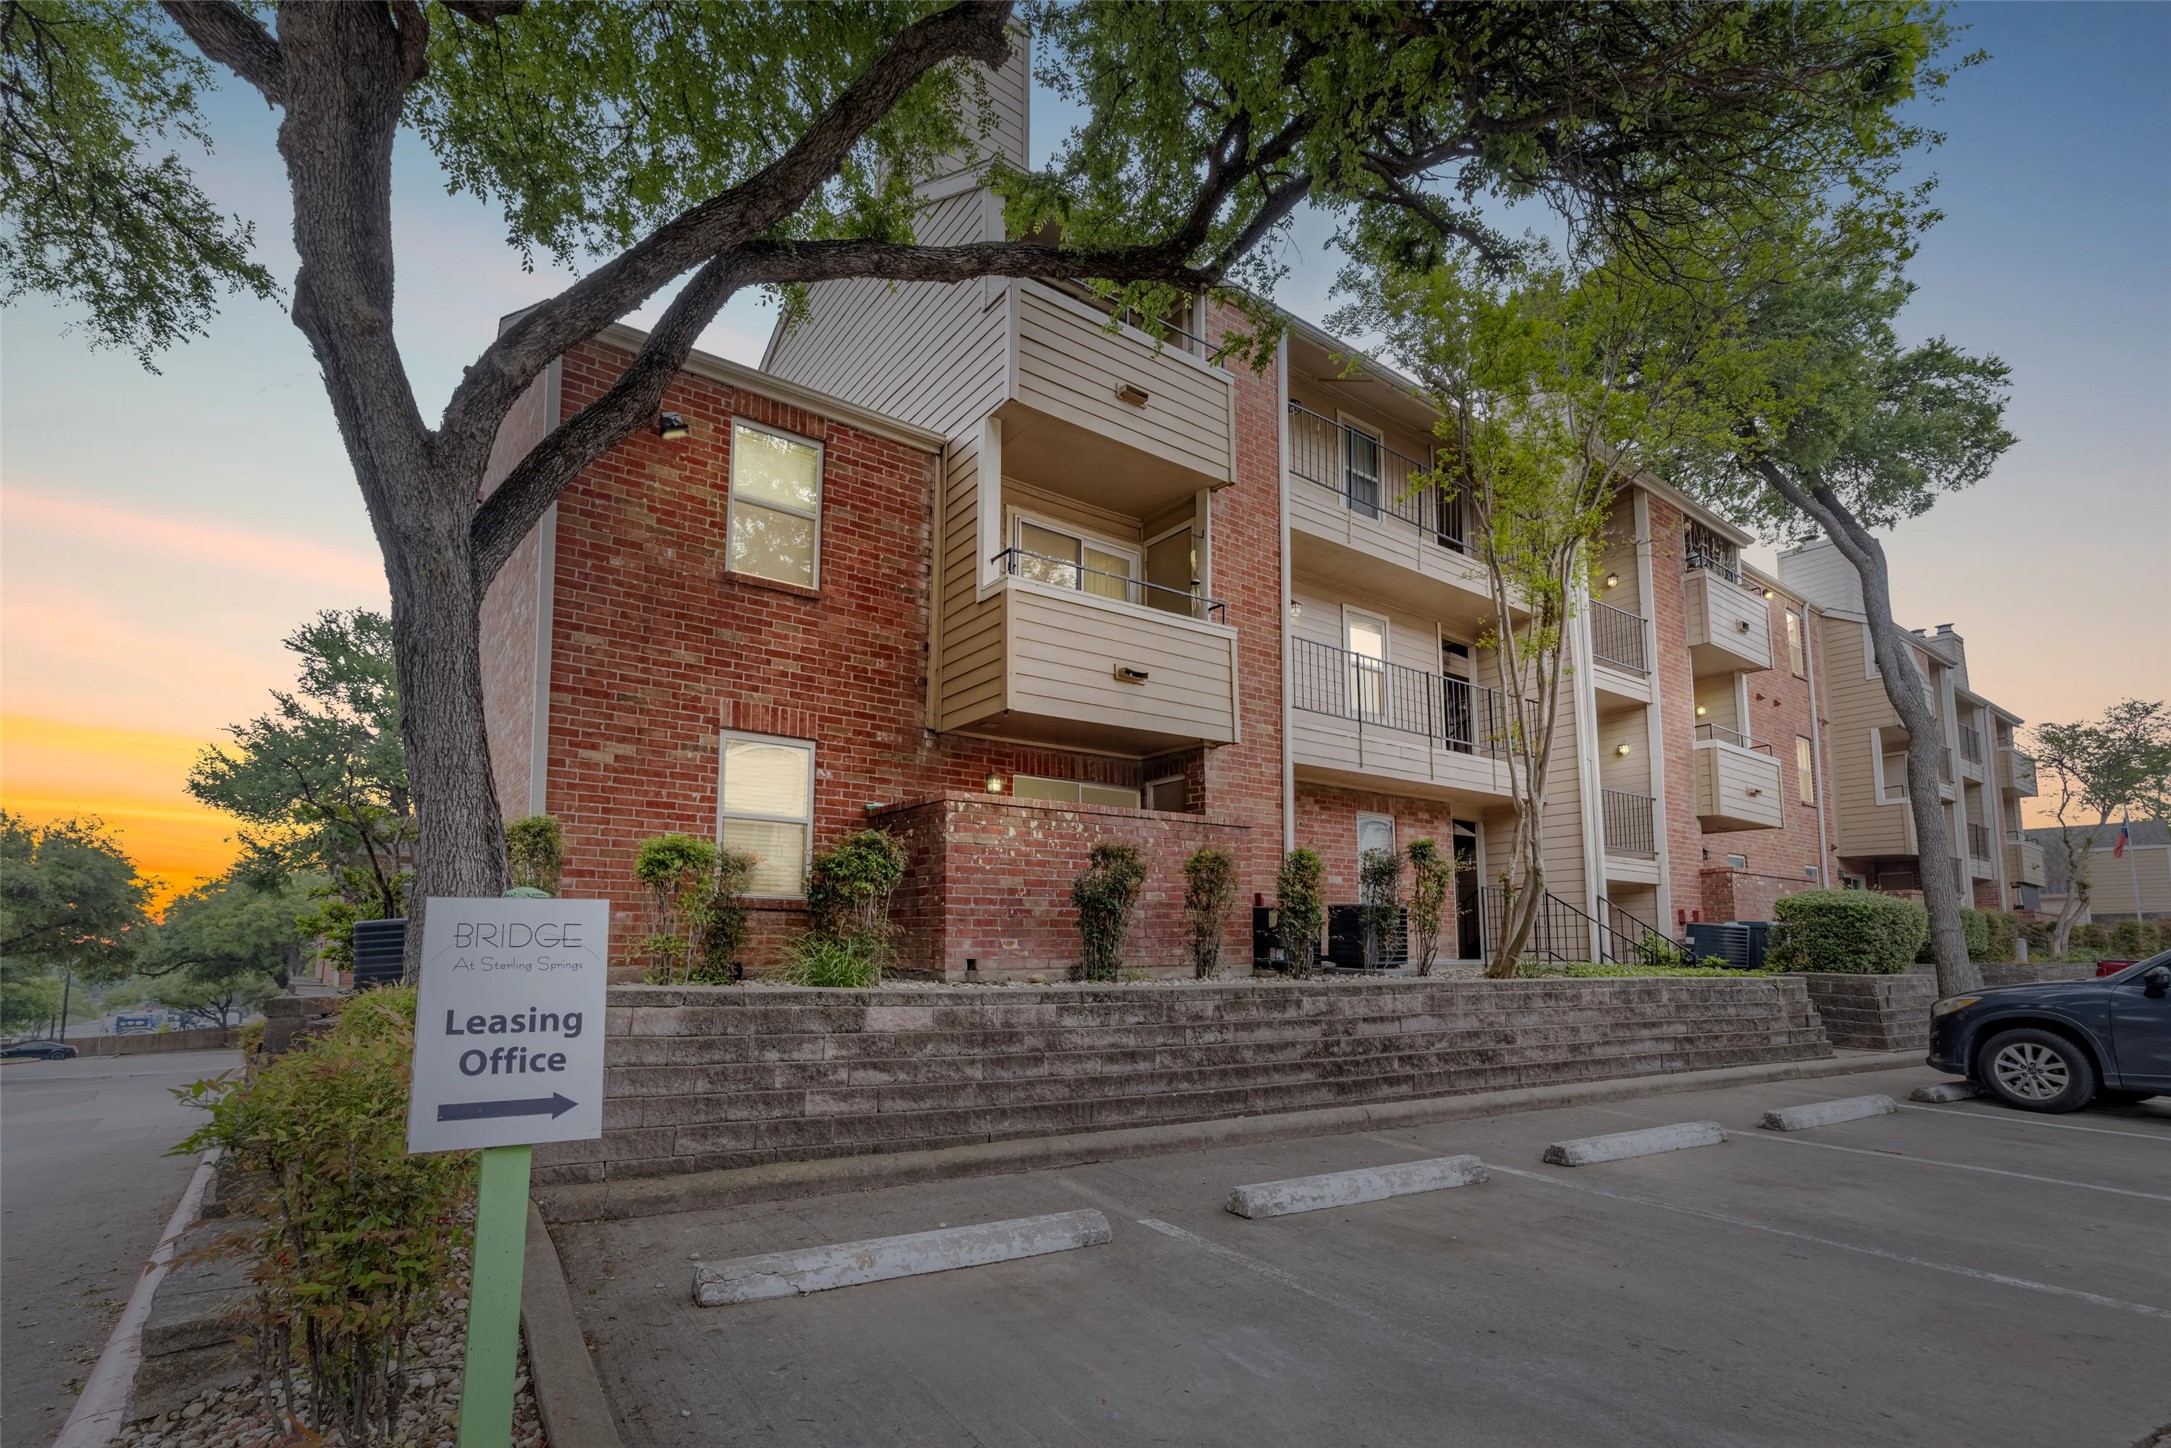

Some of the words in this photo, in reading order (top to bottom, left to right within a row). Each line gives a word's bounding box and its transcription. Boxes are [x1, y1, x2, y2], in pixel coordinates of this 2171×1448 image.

[454, 923, 583, 948] BRIDGE
[453, 957, 475, 972] At
[481, 956, 532, 972] Sterling
[537, 956, 583, 972] Springs
[445, 1006, 583, 1038] Leasing
[459, 1046, 567, 1076] Office
